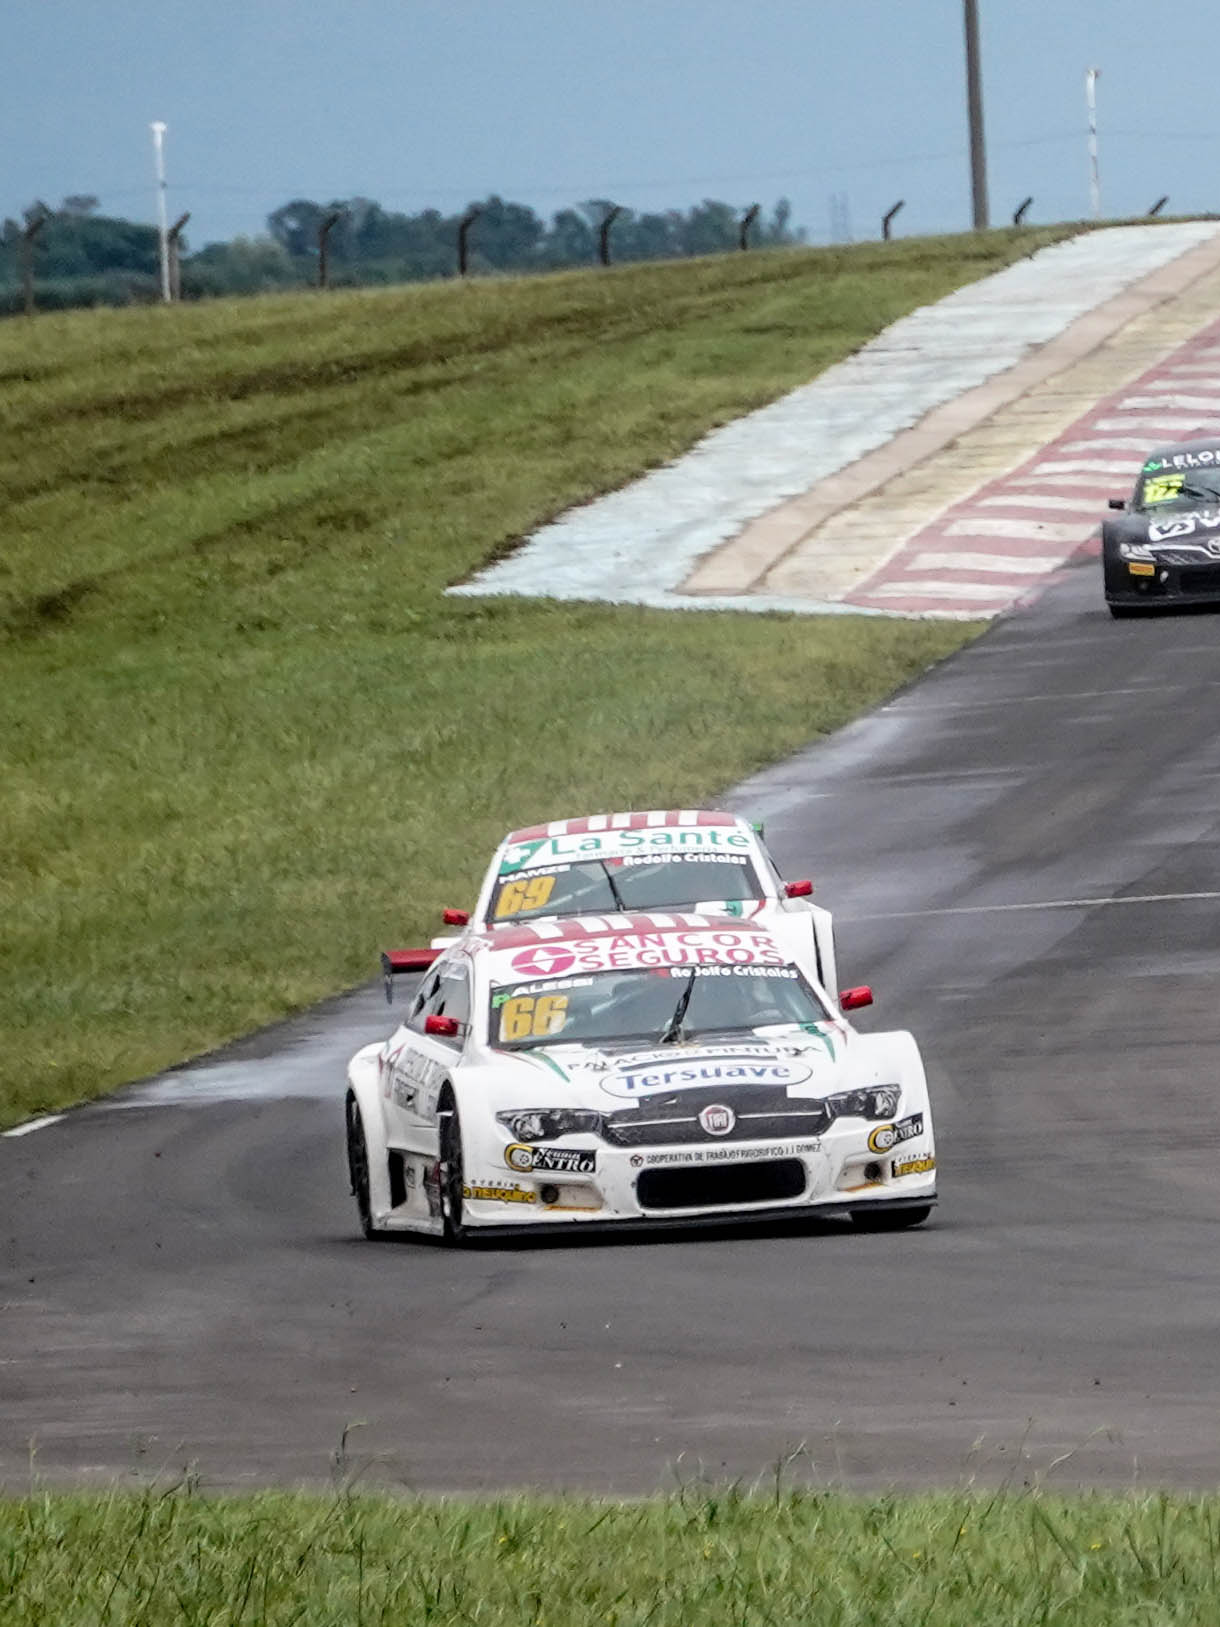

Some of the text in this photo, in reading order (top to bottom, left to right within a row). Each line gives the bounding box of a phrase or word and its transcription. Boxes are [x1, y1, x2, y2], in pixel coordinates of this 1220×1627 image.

[551, 829, 750, 856] La Santé
[495, 875, 557, 918] 69
[573, 934, 777, 955] SANCOR
[573, 948, 784, 971] SEGUROS
[733, 966, 799, 979] Cristales
[500, 996, 569, 1042] 66
[616, 1064, 791, 1090] Tersuave
